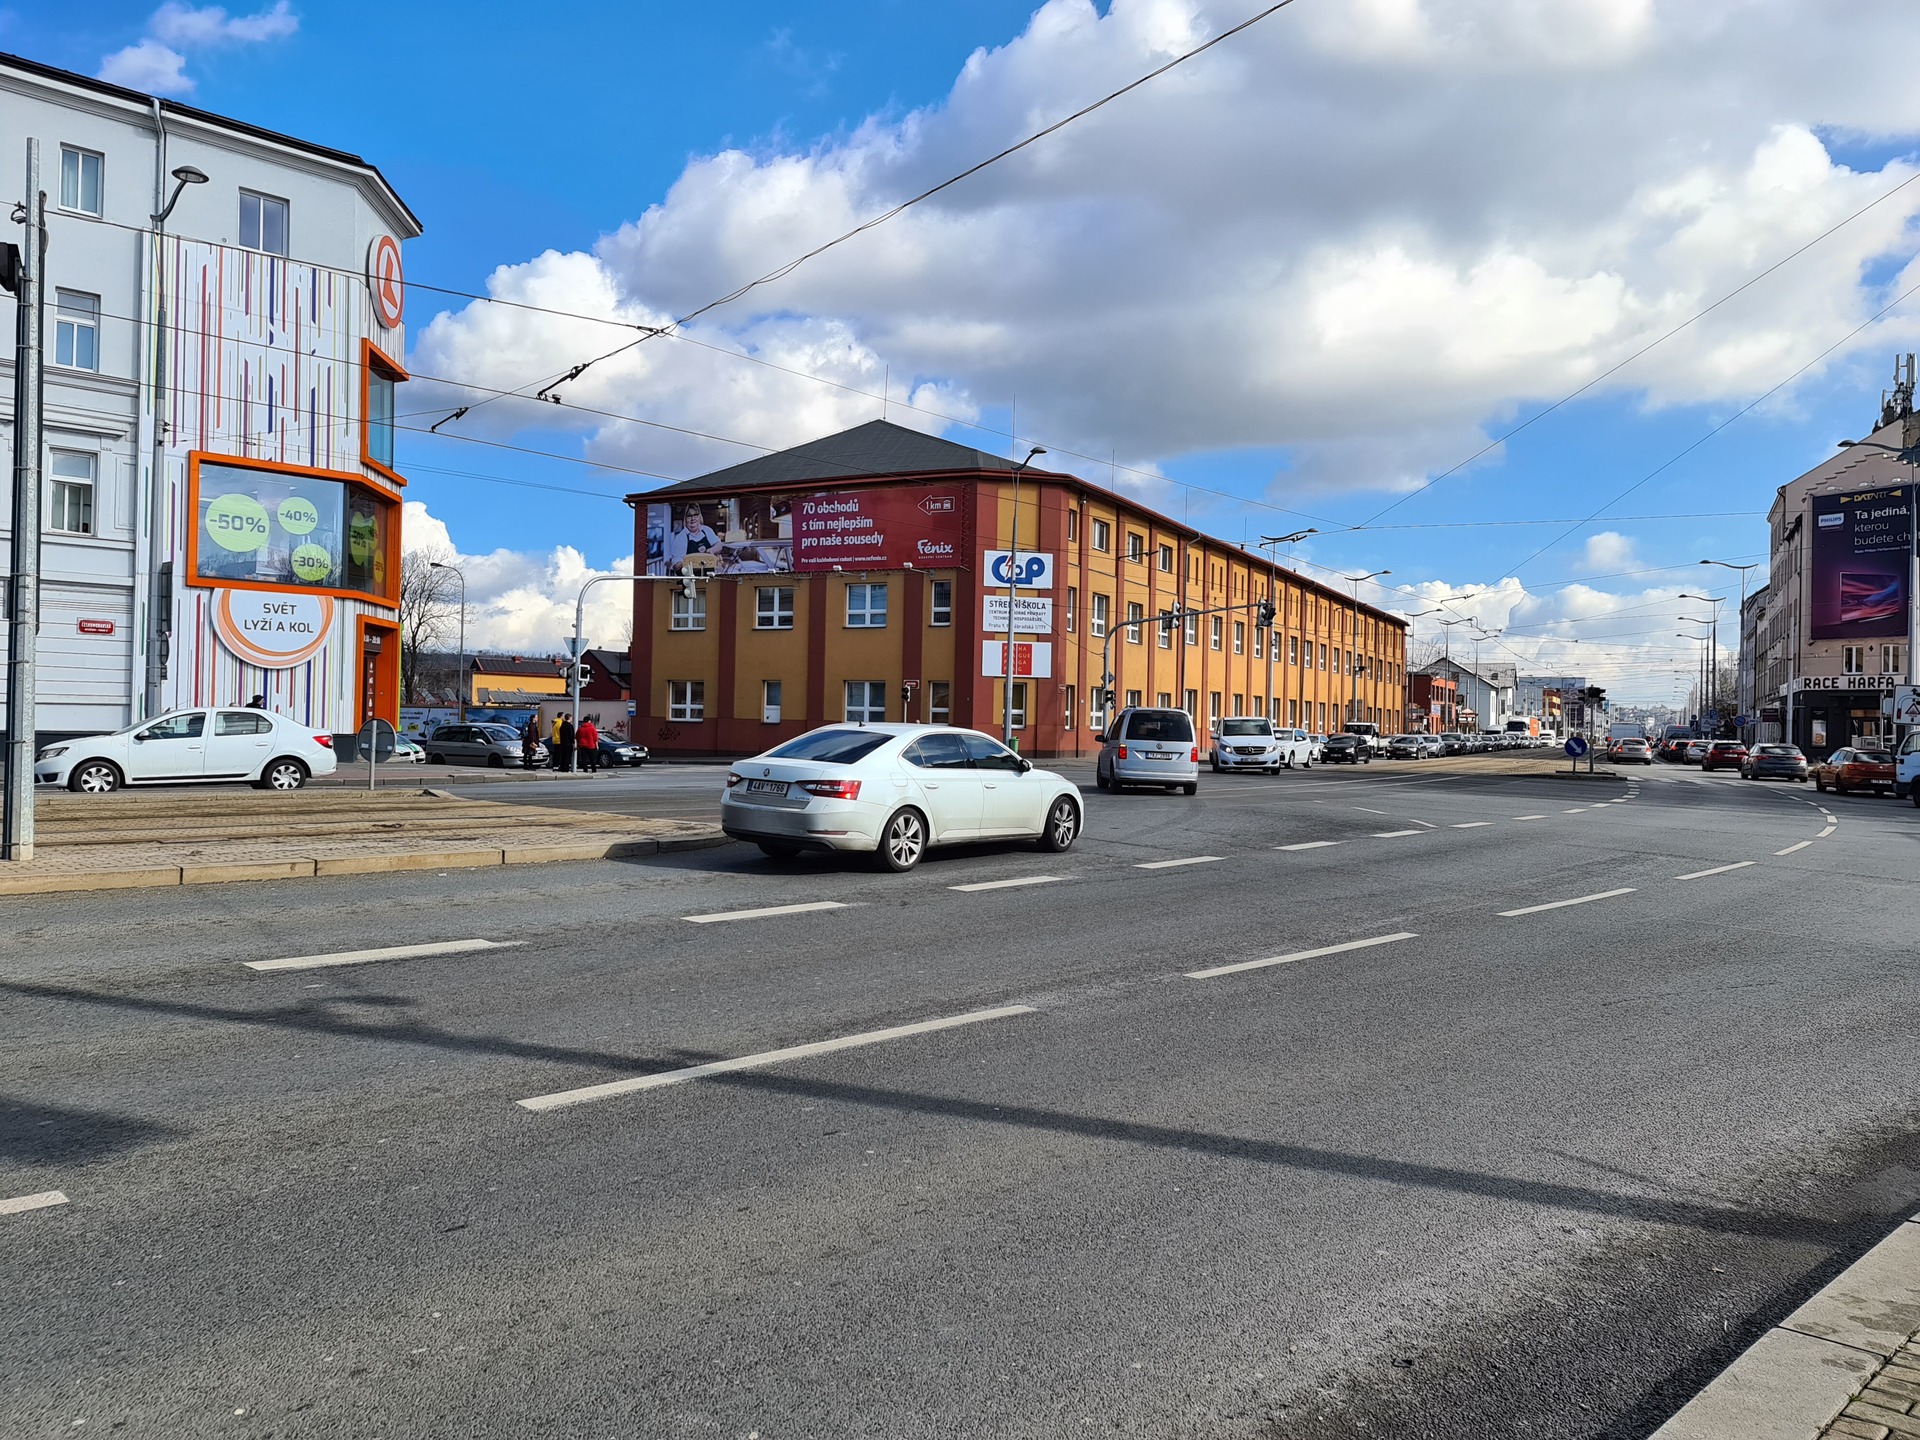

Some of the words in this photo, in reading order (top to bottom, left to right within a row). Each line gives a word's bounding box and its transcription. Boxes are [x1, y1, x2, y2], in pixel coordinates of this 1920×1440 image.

[1854, 491, 1888, 502] DATART
[802, 502, 815, 514] 70
[817, 498, 859, 513] obchodů
[930, 501, 941, 509] km
[280, 510, 316, 523] -40%
[1854, 510, 1868, 520] Ta
[1870, 505, 1910, 520] jediná,
[209, 513, 266, 534] -50%
[802, 522, 807, 530] s
[809, 519, 825, 530] tím
[827, 516, 873, 532] nejlepším
[1854, 522, 1889, 533] kterou
[801, 537, 819, 549] pro
[820, 534, 842, 546] naše
[844, 531, 883, 547] sousedy
[917, 539, 954, 554] Fénix
[1854, 534, 1894, 546] budete
[293, 556, 329, 569] -30%
[263, 601, 297, 615] SVĚT
[1022, 600, 1046, 610] ŠKOLA
[244, 617, 272, 631] LYŽÍ
[276, 621, 285, 632] A
[289, 622, 314, 633] KOL
[1847, 676, 1895, 689] HARFA
[753, 780, 765, 791] 4AV
